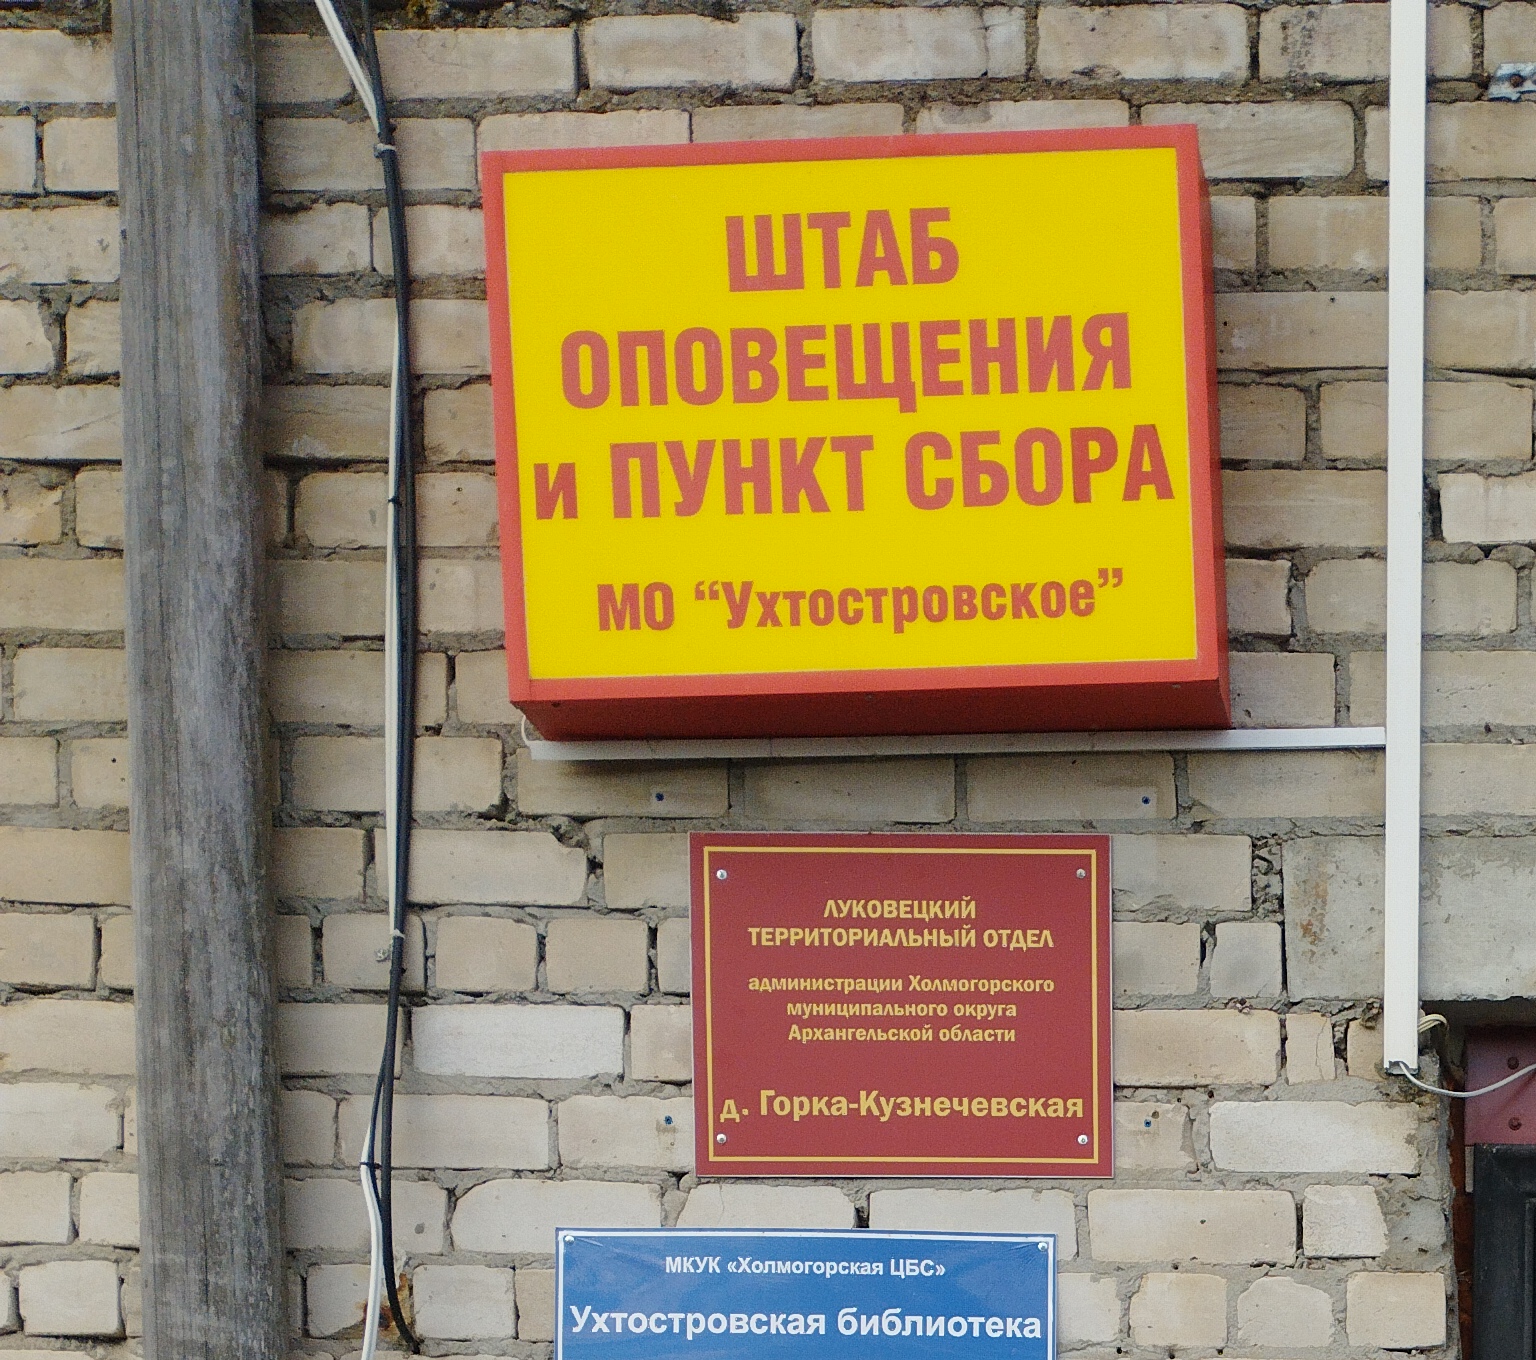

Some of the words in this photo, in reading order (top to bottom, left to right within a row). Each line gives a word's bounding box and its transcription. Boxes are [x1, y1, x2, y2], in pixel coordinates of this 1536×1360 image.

[725, 207, 959, 292] ШТАБ
[560, 312, 1132, 413] ОПОВЕЩЕНИЯ
[534, 462, 578, 520] и
[610, 434, 874, 519] ПУНКТ
[905, 424, 1175, 511] СБОРА
[597, 581, 675, 632] МО
[823, 896, 976, 923] ЛУКОВЕЦКИЙ
[748, 925, 976, 948] ТЕРРИТОРИАЛЬНЫЙ
[983, 929, 1054, 951] ОТДЕЛ
[748, 976, 903, 994] администрации
[908, 975, 1055, 995] Холмогорского
[787, 1002, 948, 1019] муниципального
[953, 1003, 1017, 1020] округа
[788, 1025, 933, 1044] Архангельской
[939, 1025, 1015, 1042] области
[720, 1097, 749, 1123] д.
[760, 1089, 1083, 1121] Горка-Кузнечевская
[665, 1256, 721, 1274] МКУК
[727, 1256, 884, 1278] «Холмогорская
[890, 1258, 946, 1279] ЦБС»
[570, 1305, 826, 1340] Ухтостровская
[838, 1308, 1042, 1339] библиотека
